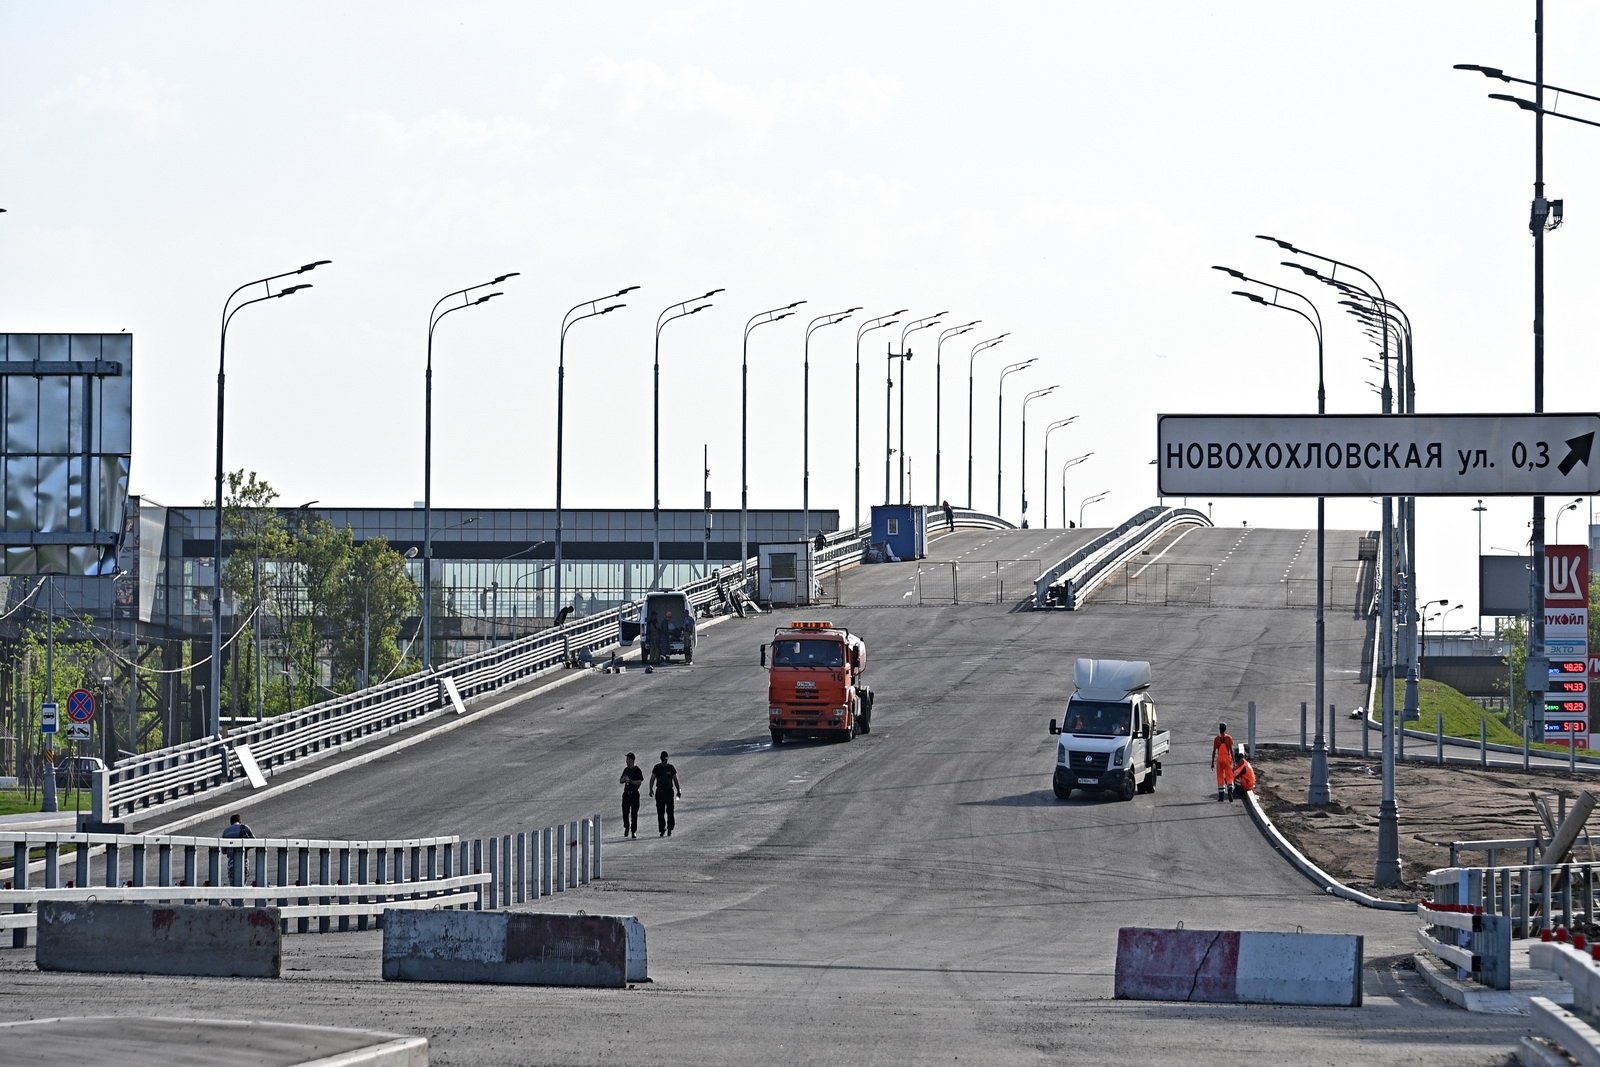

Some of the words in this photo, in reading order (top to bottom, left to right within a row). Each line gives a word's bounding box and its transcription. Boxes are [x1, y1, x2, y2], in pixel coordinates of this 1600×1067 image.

[1166, 441, 1442, 470] НОВОХОХЛОВСКАЯ
[1457, 448, 1495, 475] ул.
[1511, 441, 1550, 473] 0,3
[1545, 613, 1584, 625] УКОЙЛ
[1563, 682, 1584, 691] 44.33
